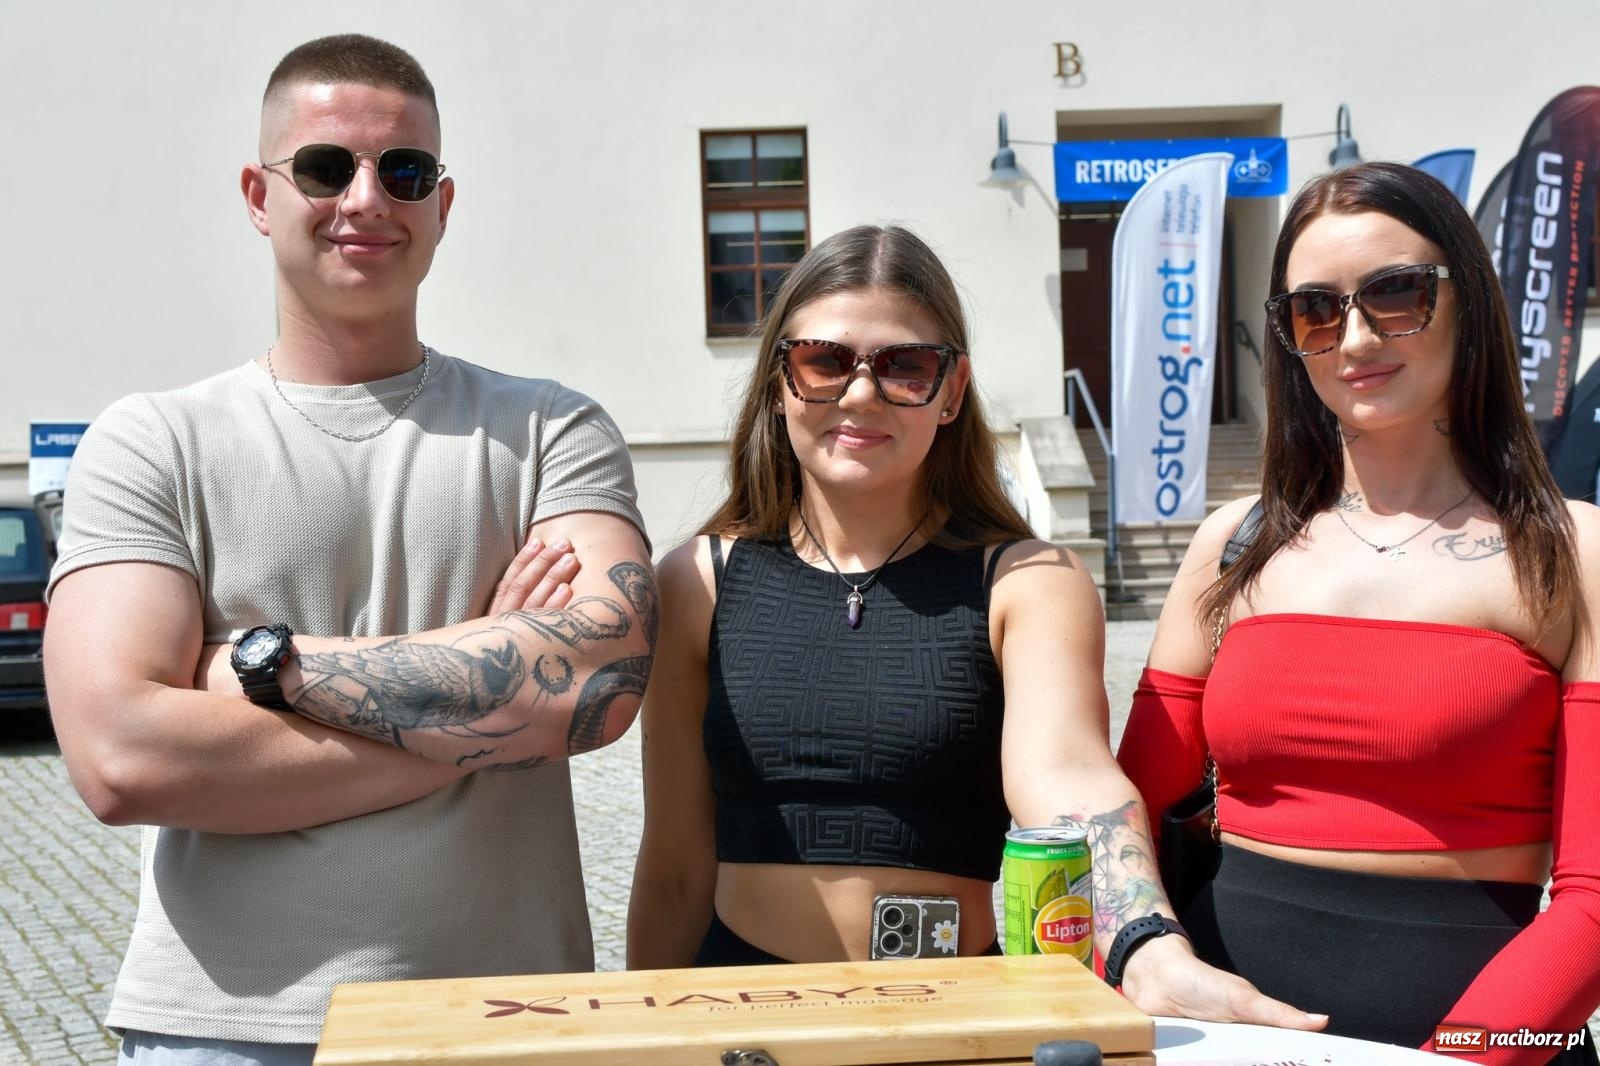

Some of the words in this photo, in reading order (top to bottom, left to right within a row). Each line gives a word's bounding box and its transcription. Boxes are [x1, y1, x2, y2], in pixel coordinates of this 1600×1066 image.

[1052, 41, 1081, 78] B
[1075, 158, 1177, 184] RETROSF
[1552, 335, 1572, 417] DISCOVER
[1563, 267, 1580, 328] BETTER
[1152, 258, 1204, 517] ostrog.net
[1046, 922, 1090, 940] Lipton
[589, 983, 936, 1009] HABYS
[708, 1004, 736, 1013] for
[750, 1000, 829, 1011] perfect
[840, 995, 944, 1006] massage
